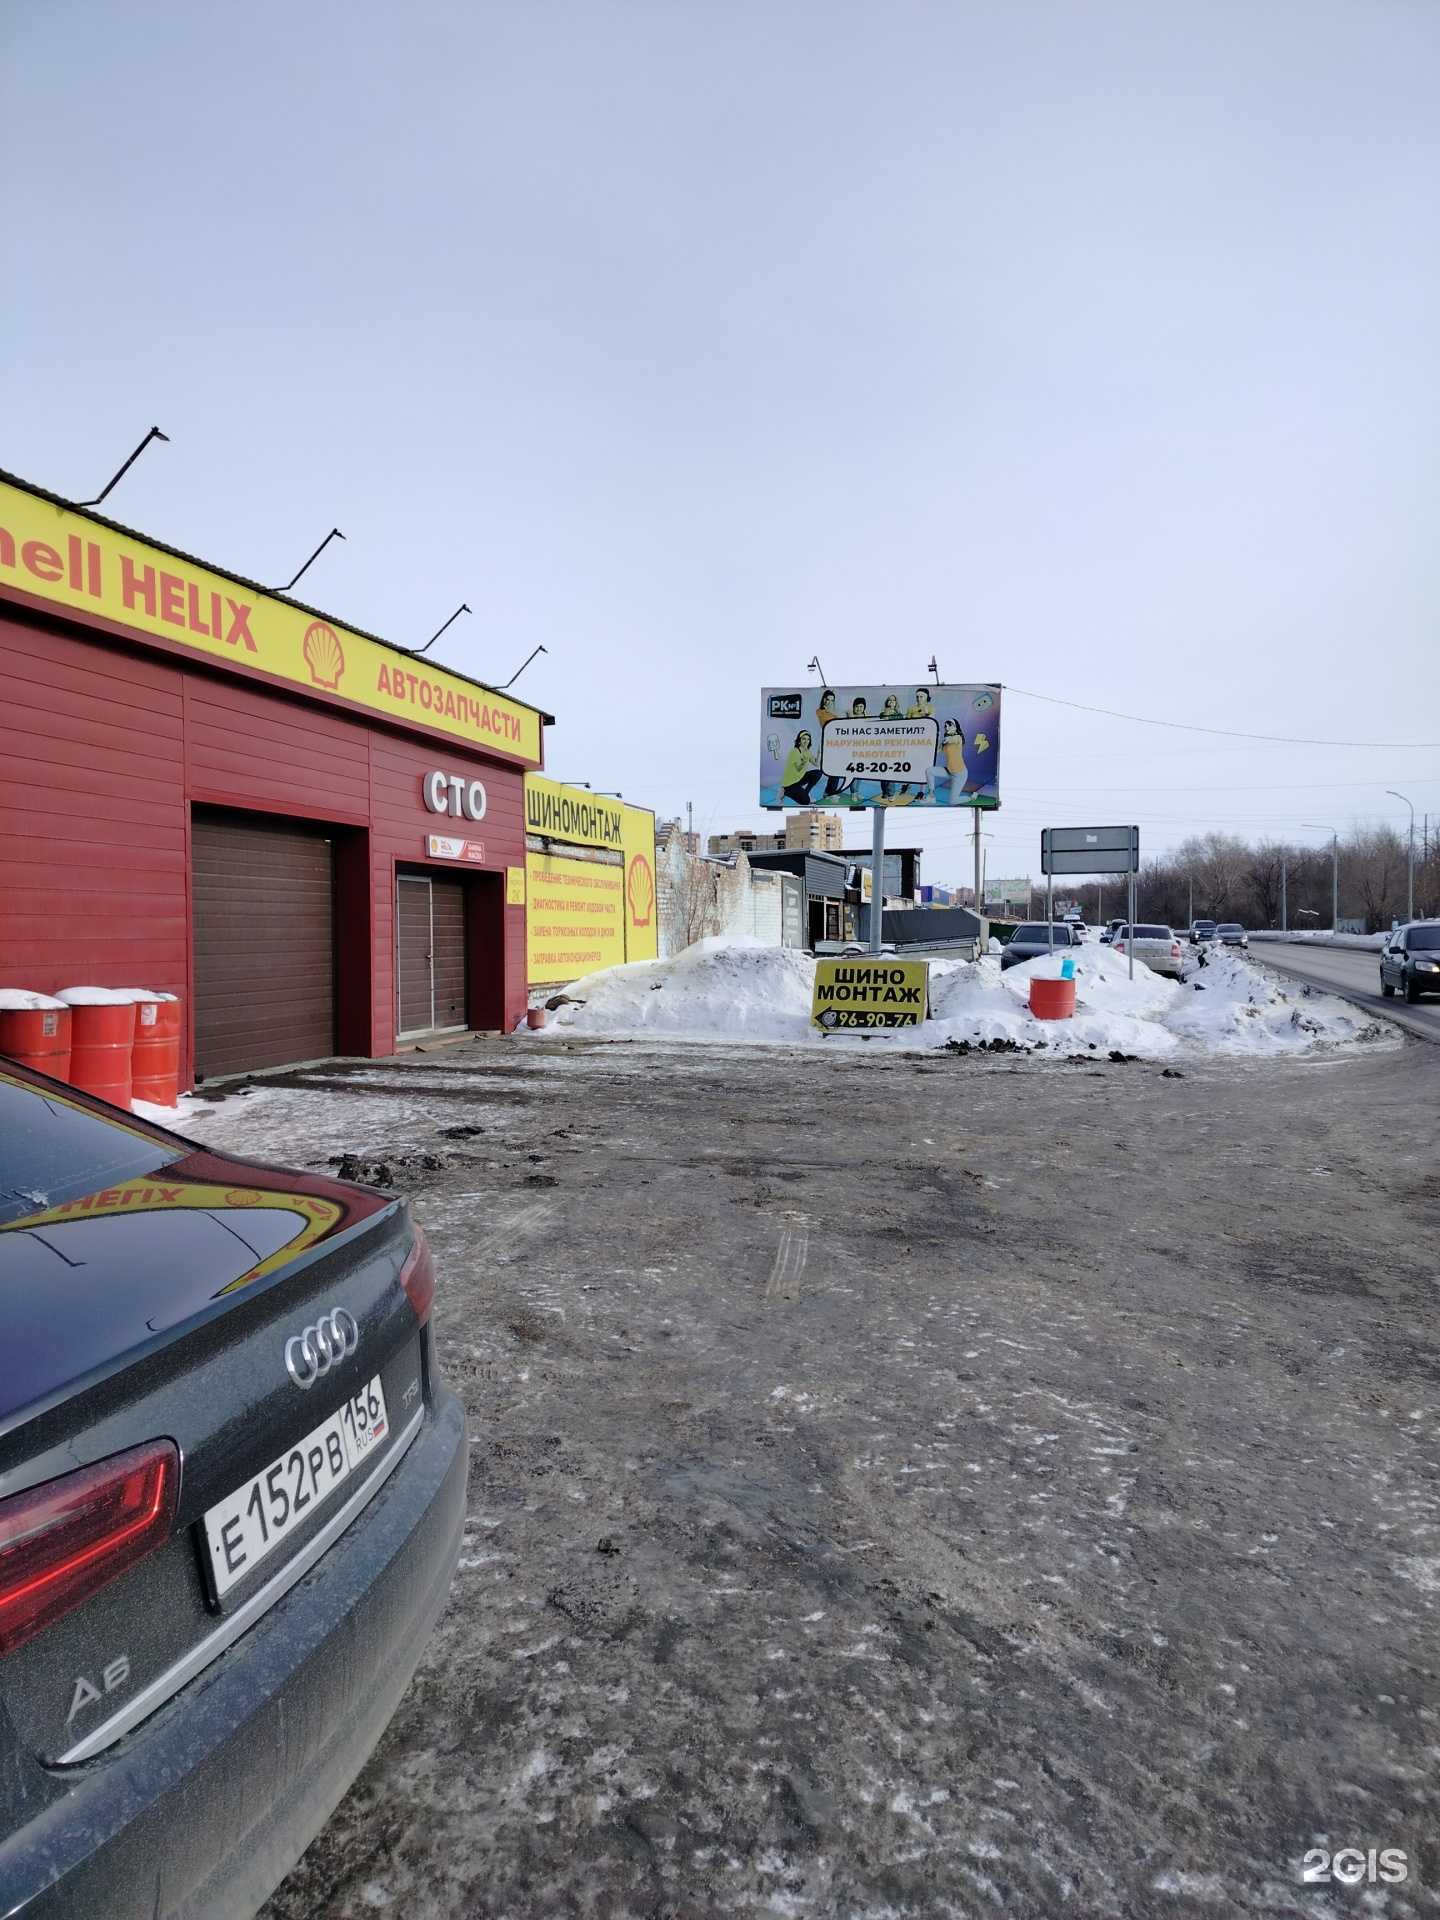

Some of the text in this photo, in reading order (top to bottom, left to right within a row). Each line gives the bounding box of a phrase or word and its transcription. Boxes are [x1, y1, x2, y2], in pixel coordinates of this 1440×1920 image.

[119, 553, 258, 653] HELIX
[377, 663, 521, 742] АВТОЗАПЧАСТИ
[874, 727, 925, 735] ЗАМЕТИЛ?
[846, 762, 911, 773] 48-20-20
[424, 771, 487, 820] СТО
[527, 789, 622, 844] ШИНОМОНТАЖ
[817, 985, 921, 1003] МОНТАЖ
[834, 968, 905, 984] ШИНО
[839, 1011, 913, 1027] 96-90-76
[356, 1426, 374, 1454] RUS
[220, 1381, 381, 1574] Е152РВ 156
[64, 1656, 130, 1726] A6
